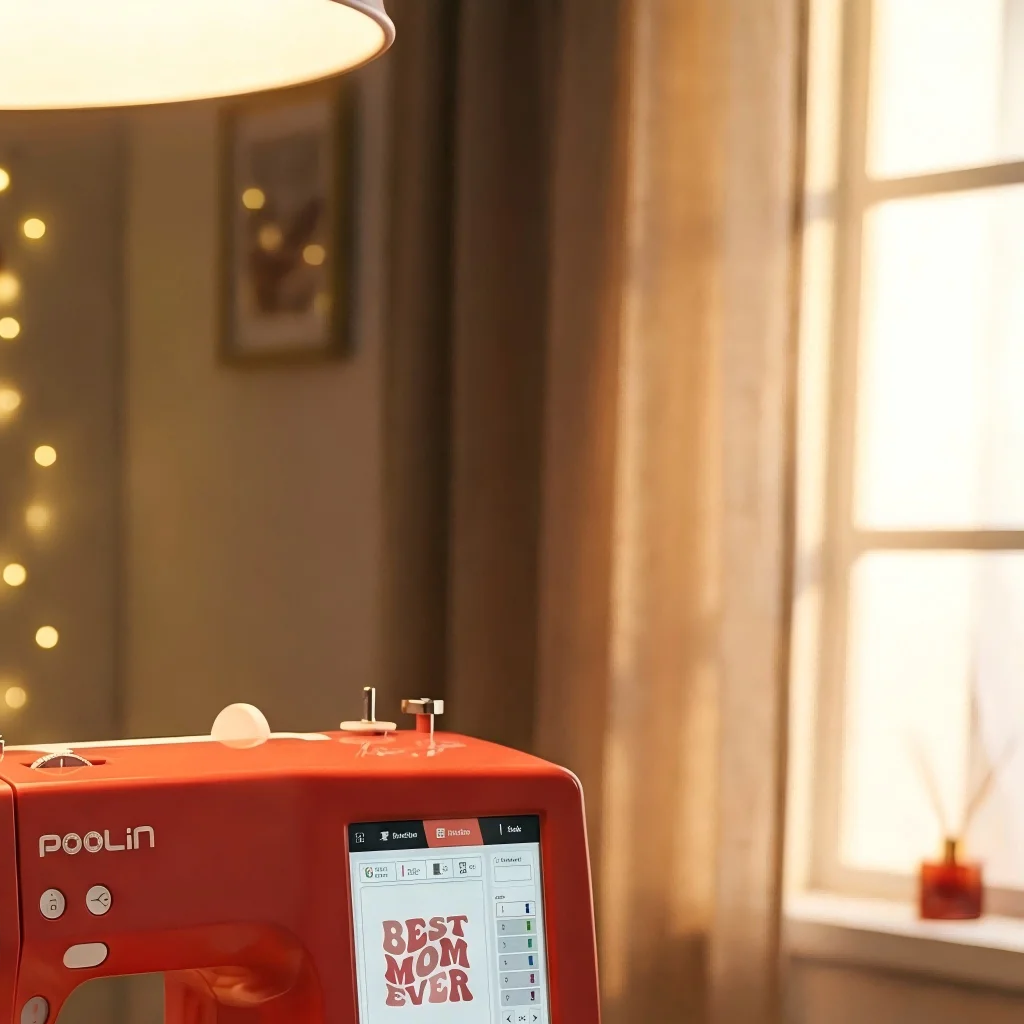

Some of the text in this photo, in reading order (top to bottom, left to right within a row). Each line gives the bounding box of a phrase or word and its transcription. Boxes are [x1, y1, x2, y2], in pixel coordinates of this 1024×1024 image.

[382, 915, 469, 955] BEST
[384, 937, 470, 985] MOM
[385, 968, 474, 1007] EVER
